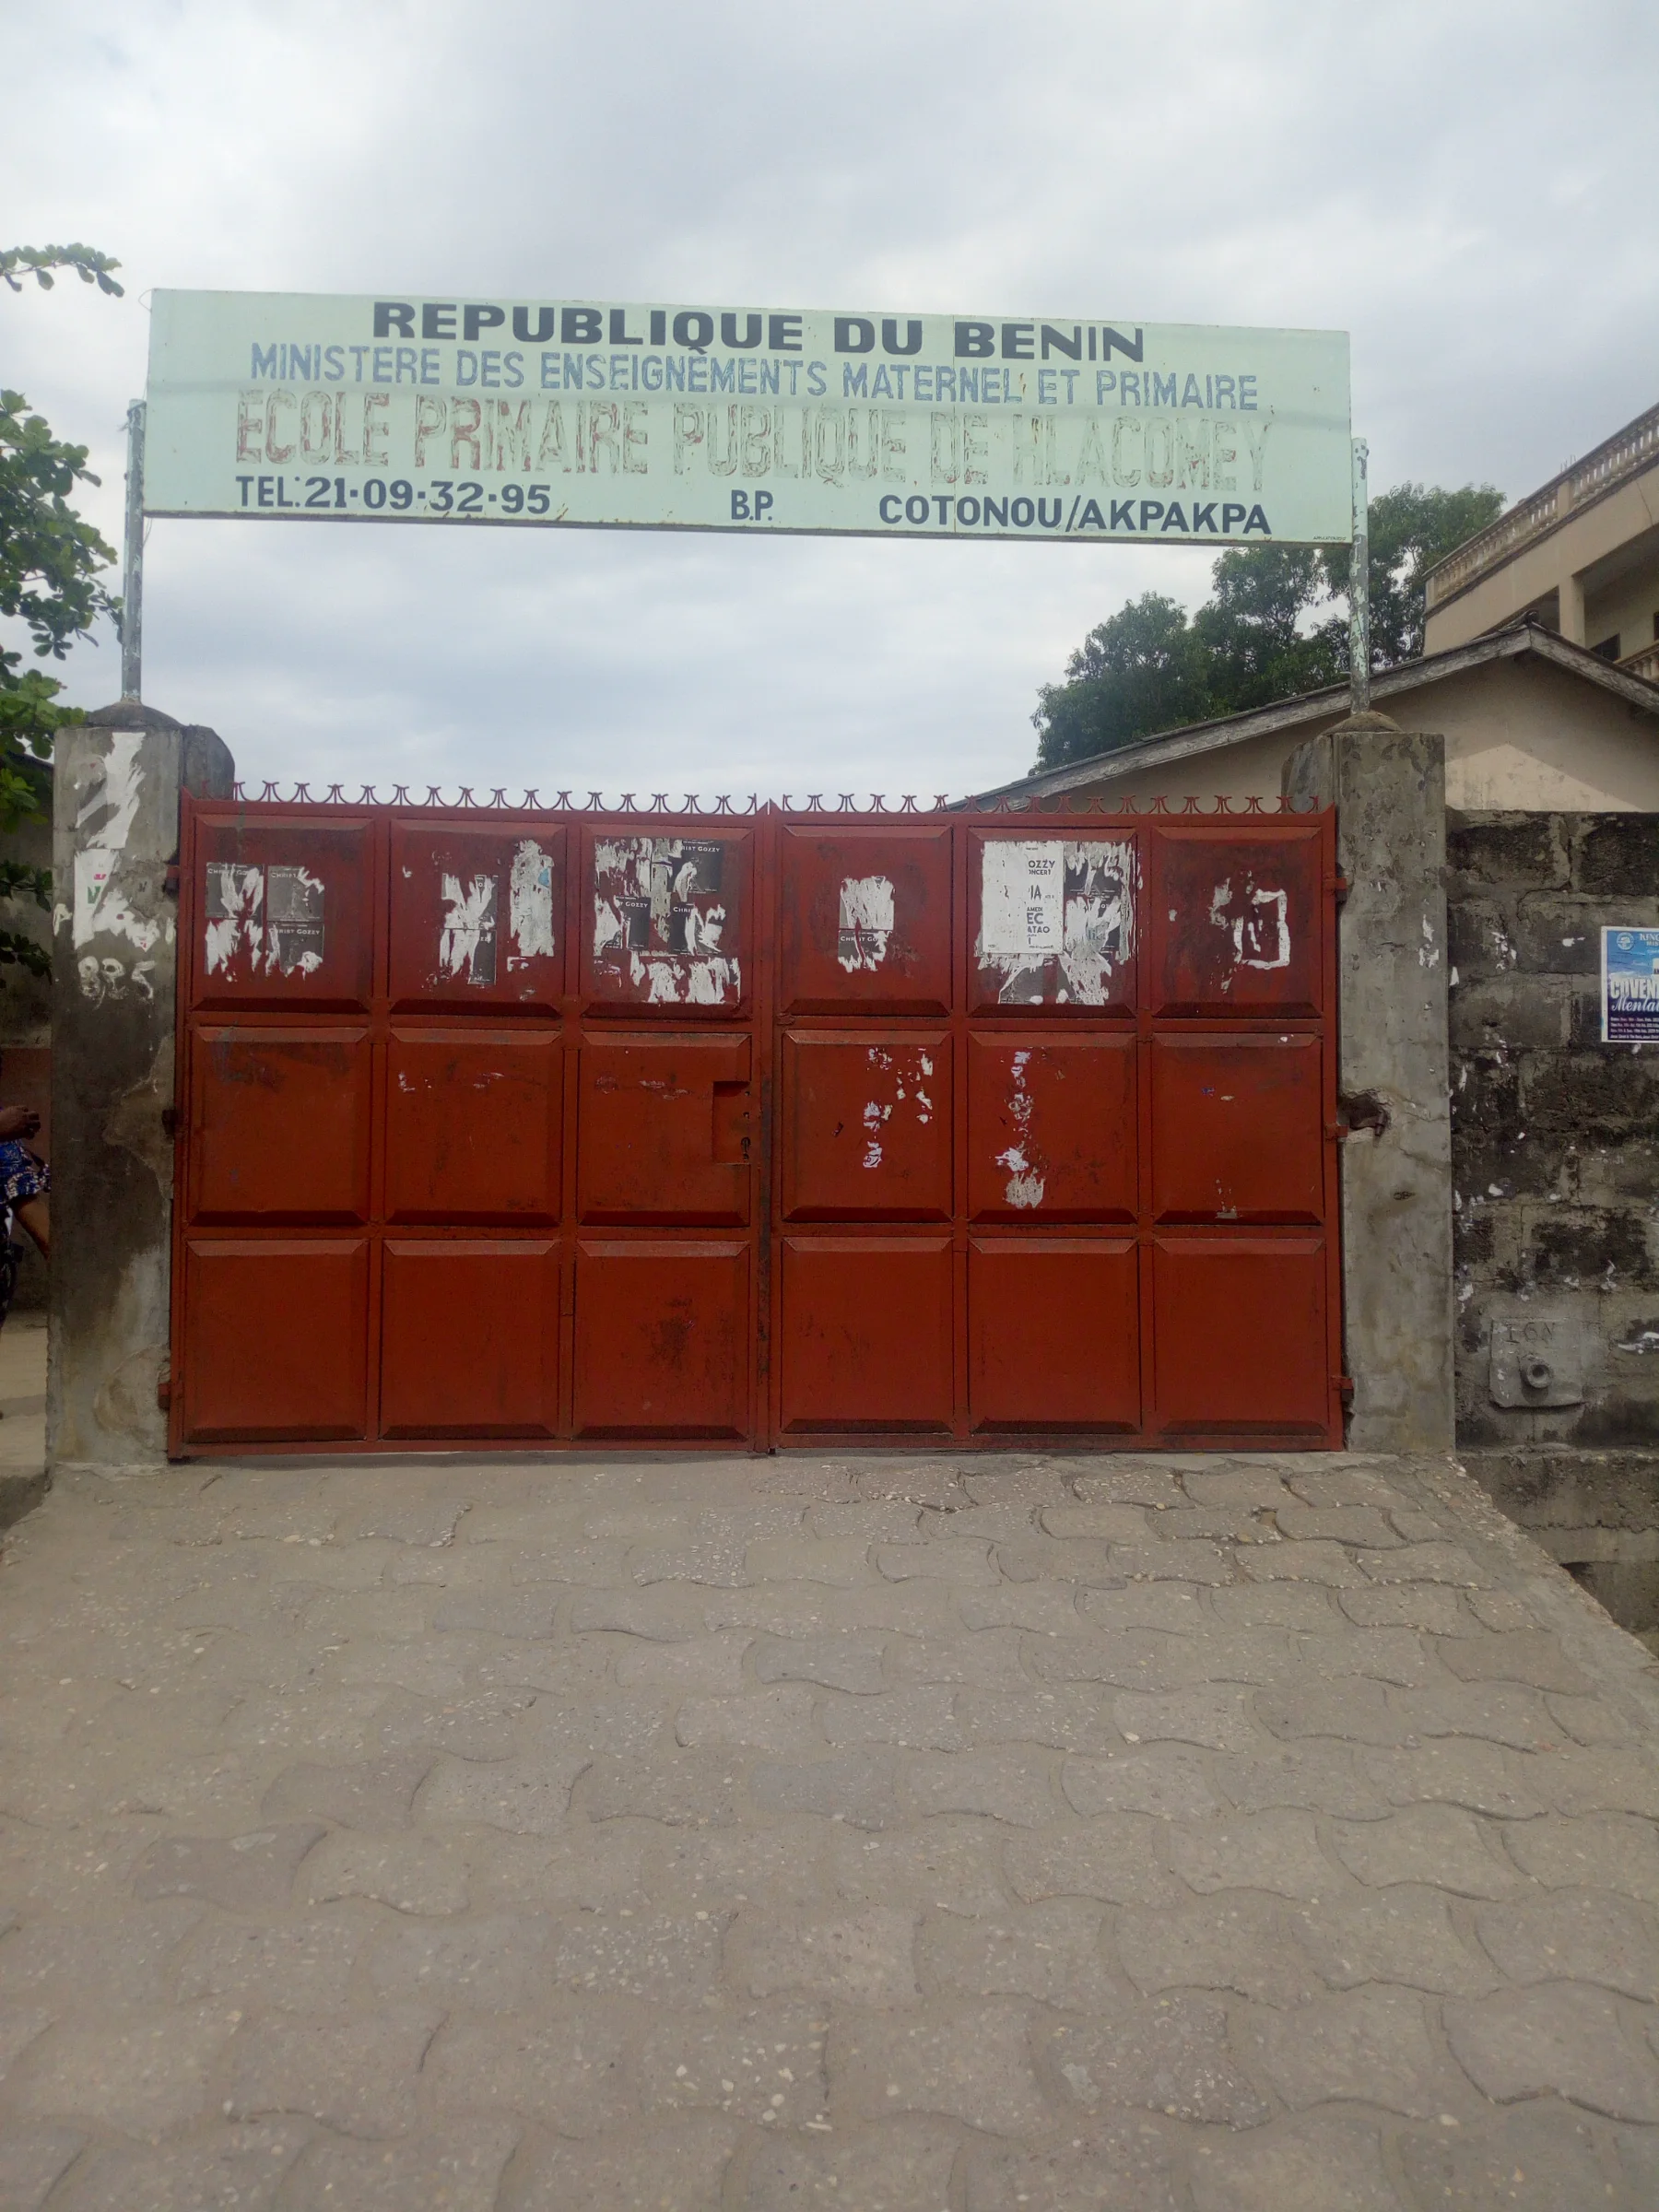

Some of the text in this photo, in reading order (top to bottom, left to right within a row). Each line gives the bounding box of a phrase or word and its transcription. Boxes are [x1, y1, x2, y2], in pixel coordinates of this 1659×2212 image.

[372, 300, 1145, 363] REPUBLIQUE DU BENIN
[251, 342, 1259, 411] MINISTERE DES ENSEIGNEMENTS MATERNEL ET PRIMAIRE
[235, 388, 390, 466] ECOLE
[414, 394, 649, 475] PRIMAIRE
[673, 402, 907, 488] PUBLIQUE
[930, 411, 989, 485] DE
[731, 489, 773, 523] B.P.
